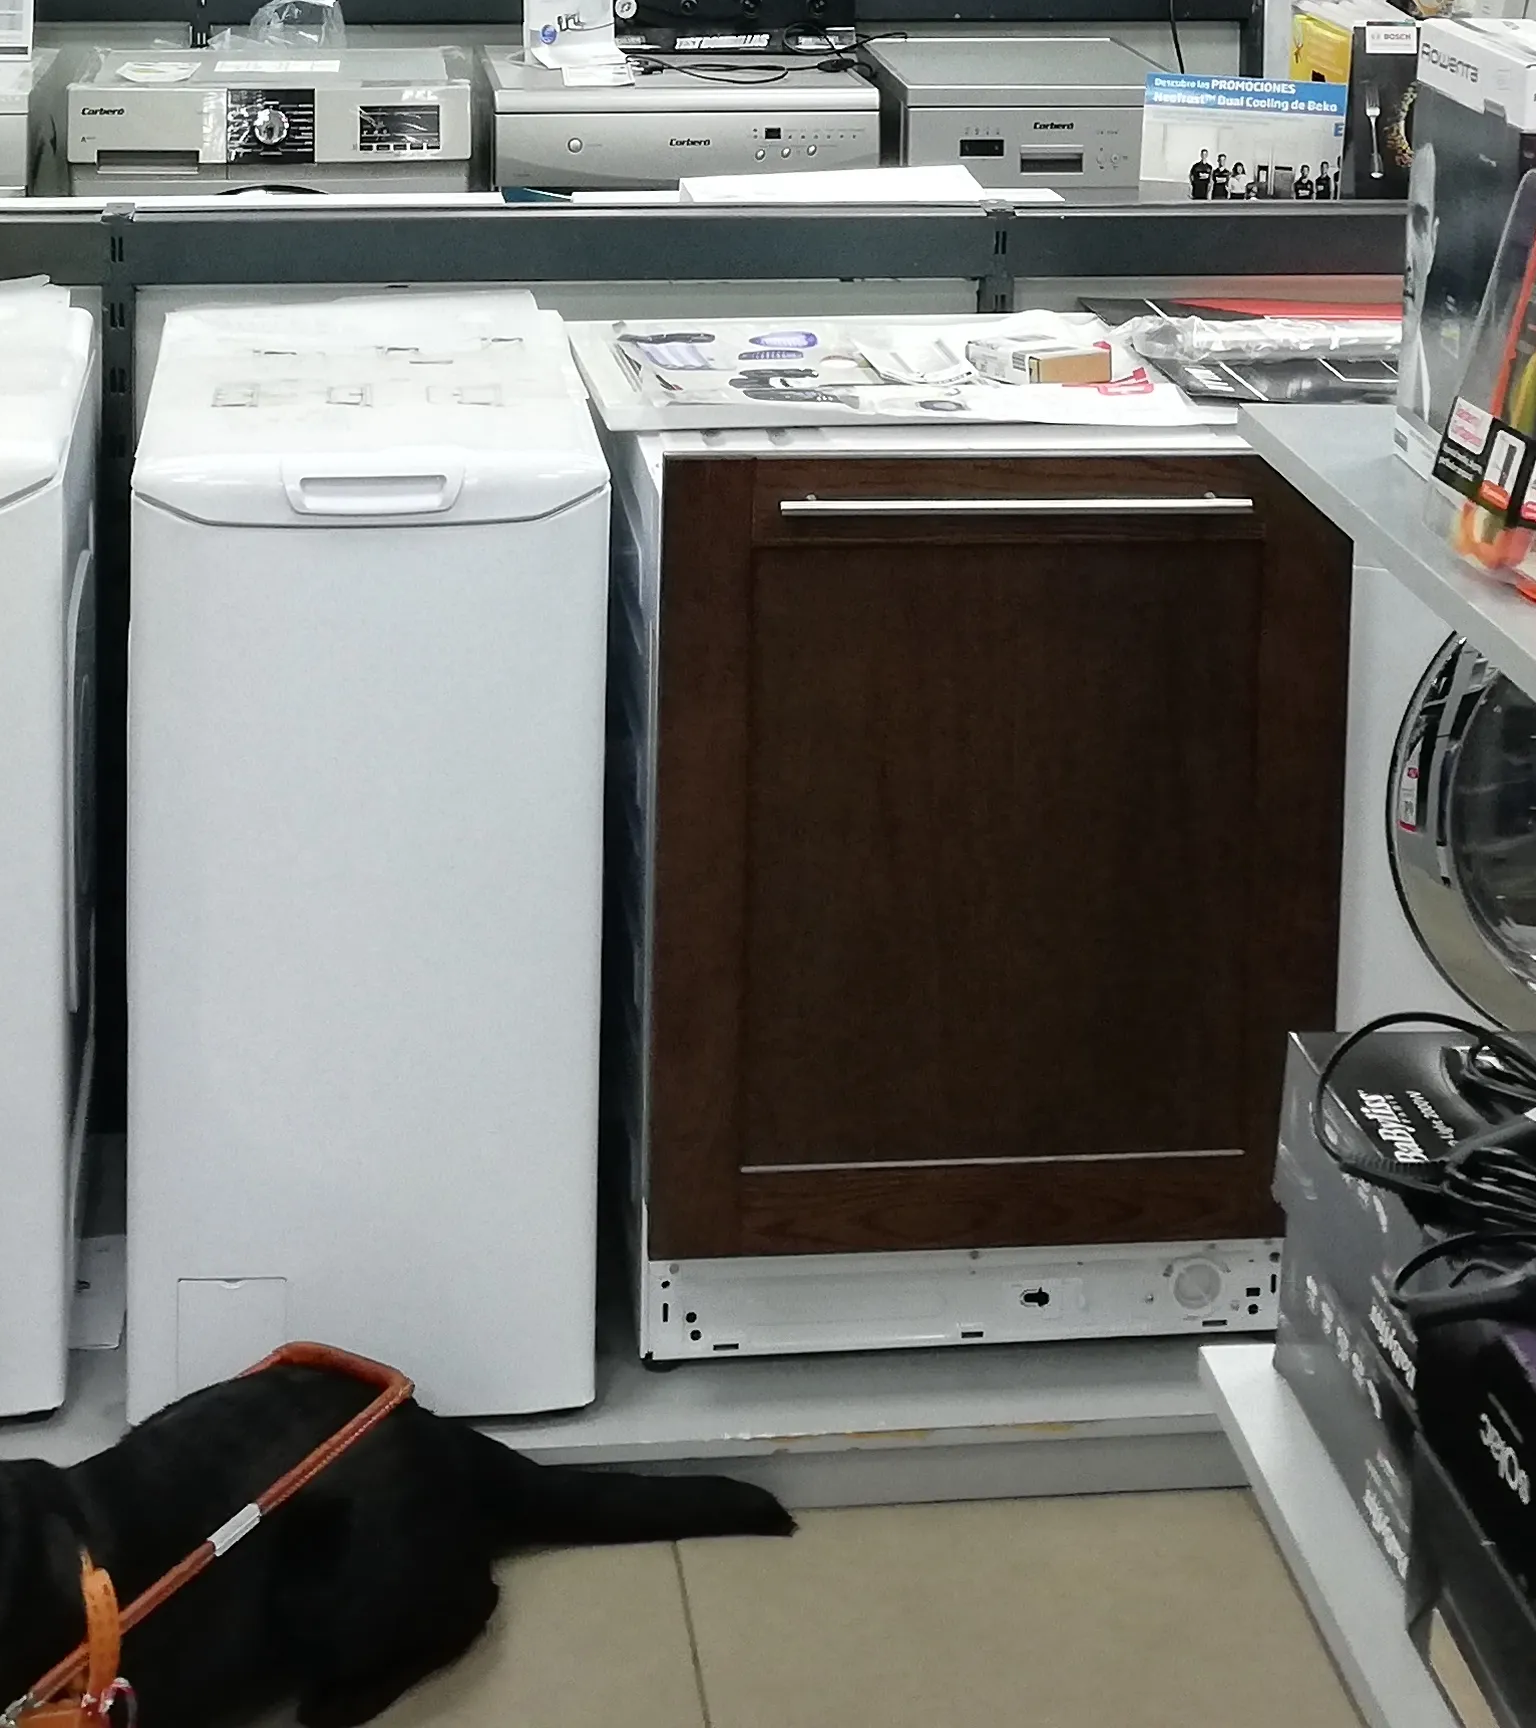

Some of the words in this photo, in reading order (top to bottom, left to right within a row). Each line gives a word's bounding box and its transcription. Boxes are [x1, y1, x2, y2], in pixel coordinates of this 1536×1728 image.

[1384, 33, 1412, 41] BOSCH
[1420, 41, 1480, 84] Rowenta
[1212, 79, 1297, 97] PROMOCIONES
[1218, 95, 1244, 107] Dual
[1246, 98, 1289, 113] Cooling
[1291, 100, 1306, 110] de
[1307, 100, 1338, 113] Beko
